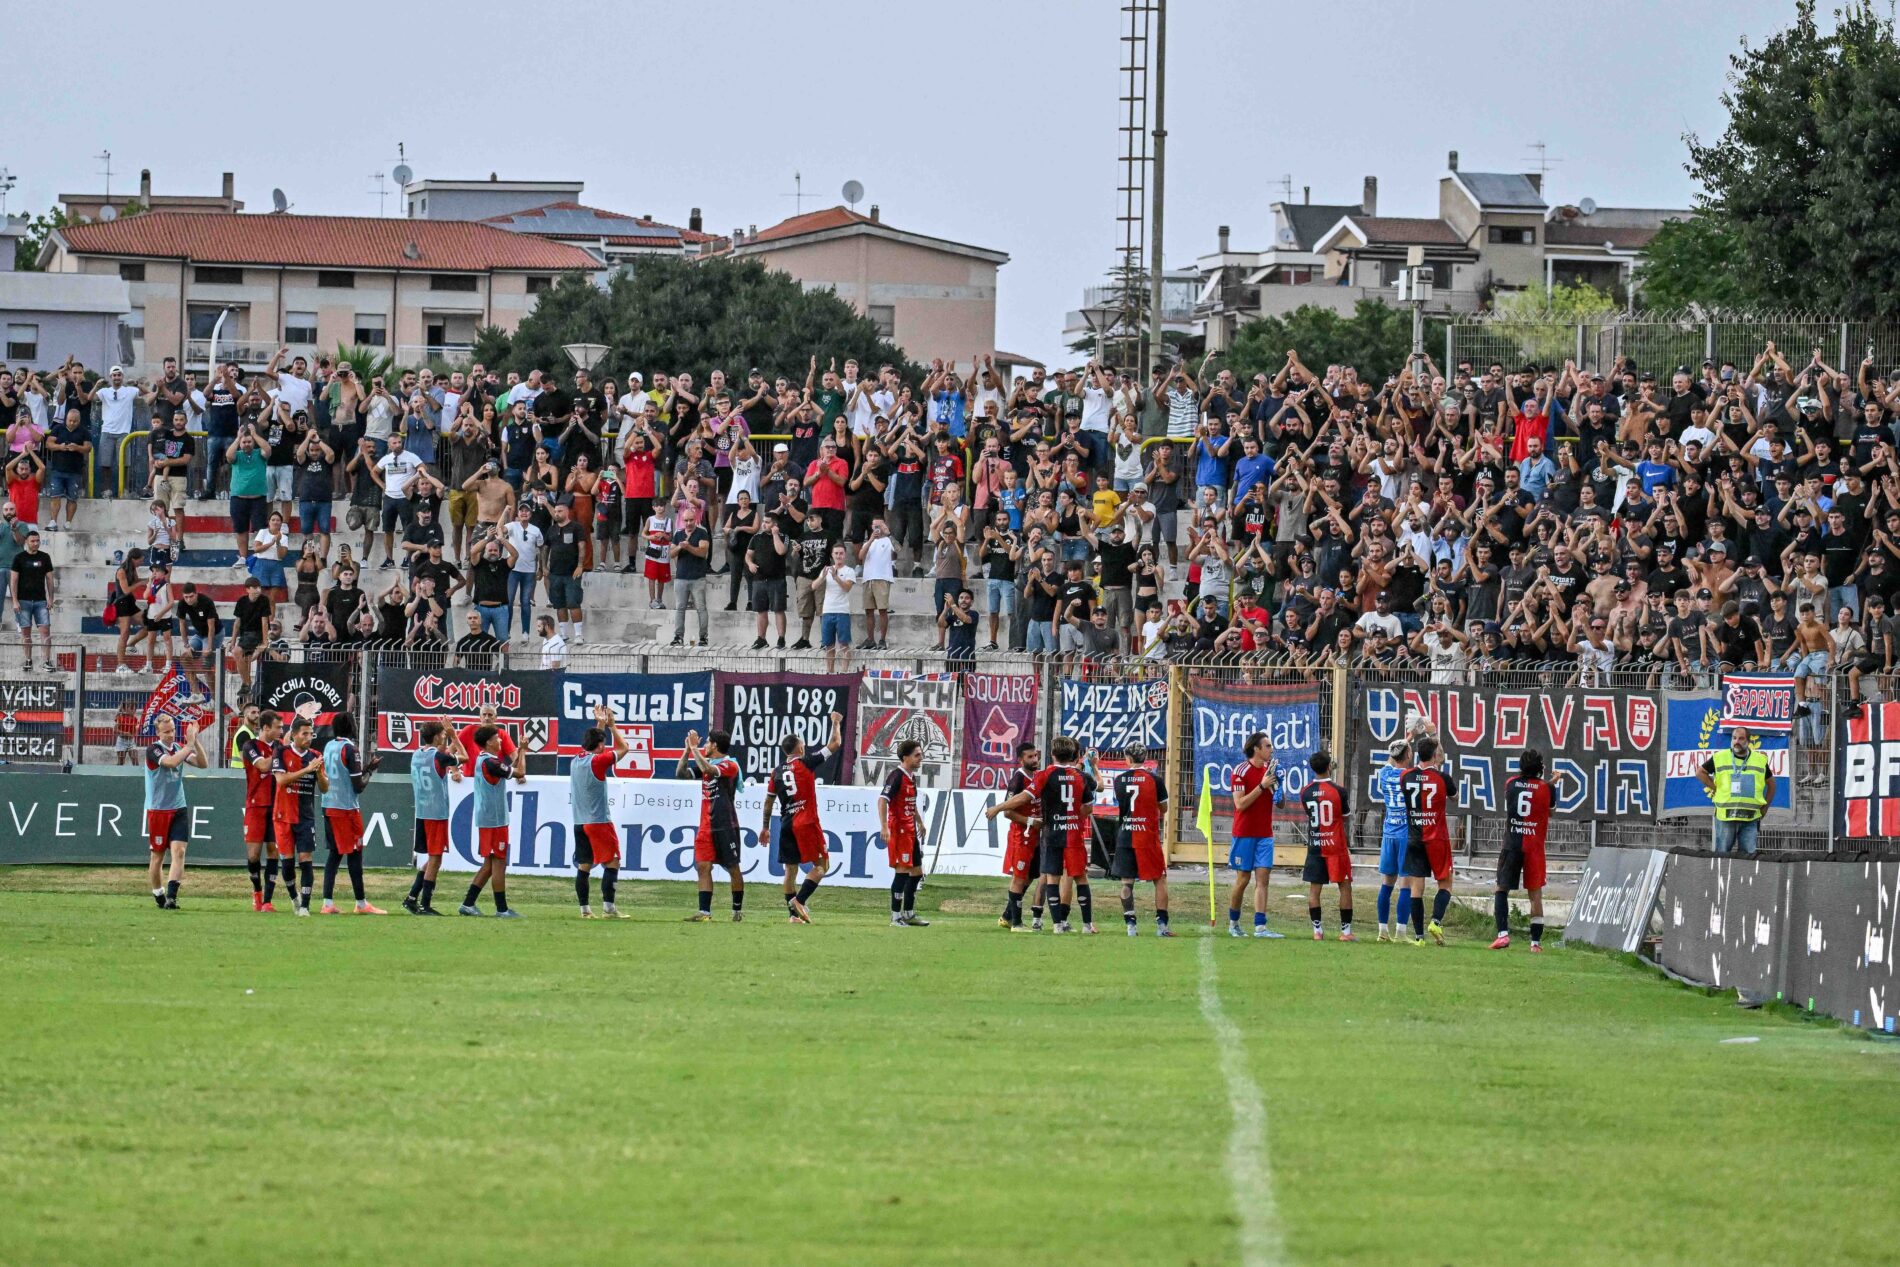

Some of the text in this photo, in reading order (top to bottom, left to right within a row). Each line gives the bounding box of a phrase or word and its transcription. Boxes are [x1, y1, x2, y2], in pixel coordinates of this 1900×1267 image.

[268, 676, 343, 707] PICCHIA TORRES
[414, 674, 521, 711] Centro
[563, 681, 705, 721] Casuals
[734, 685, 837, 716] DAL 1989
[860, 679, 955, 708] NORTH
[966, 674, 1035, 703] SQUARE
[1063, 682, 1147, 713] MADE IN
[730, 715, 829, 747] A GUARDI
[1403, 688, 1621, 751] NUOVA
[782, 770, 797, 796] 9
[1061, 784, 1075, 811] 4
[1406, 782, 1437, 809] 77
[634, 794, 693, 811] Design
[826, 800, 869, 813] Print
[1126, 785, 1139, 812] 7
[1517, 791, 1533, 817] 6
[9, 801, 215, 840] VERE
[1306, 800, 1333, 827] 30
